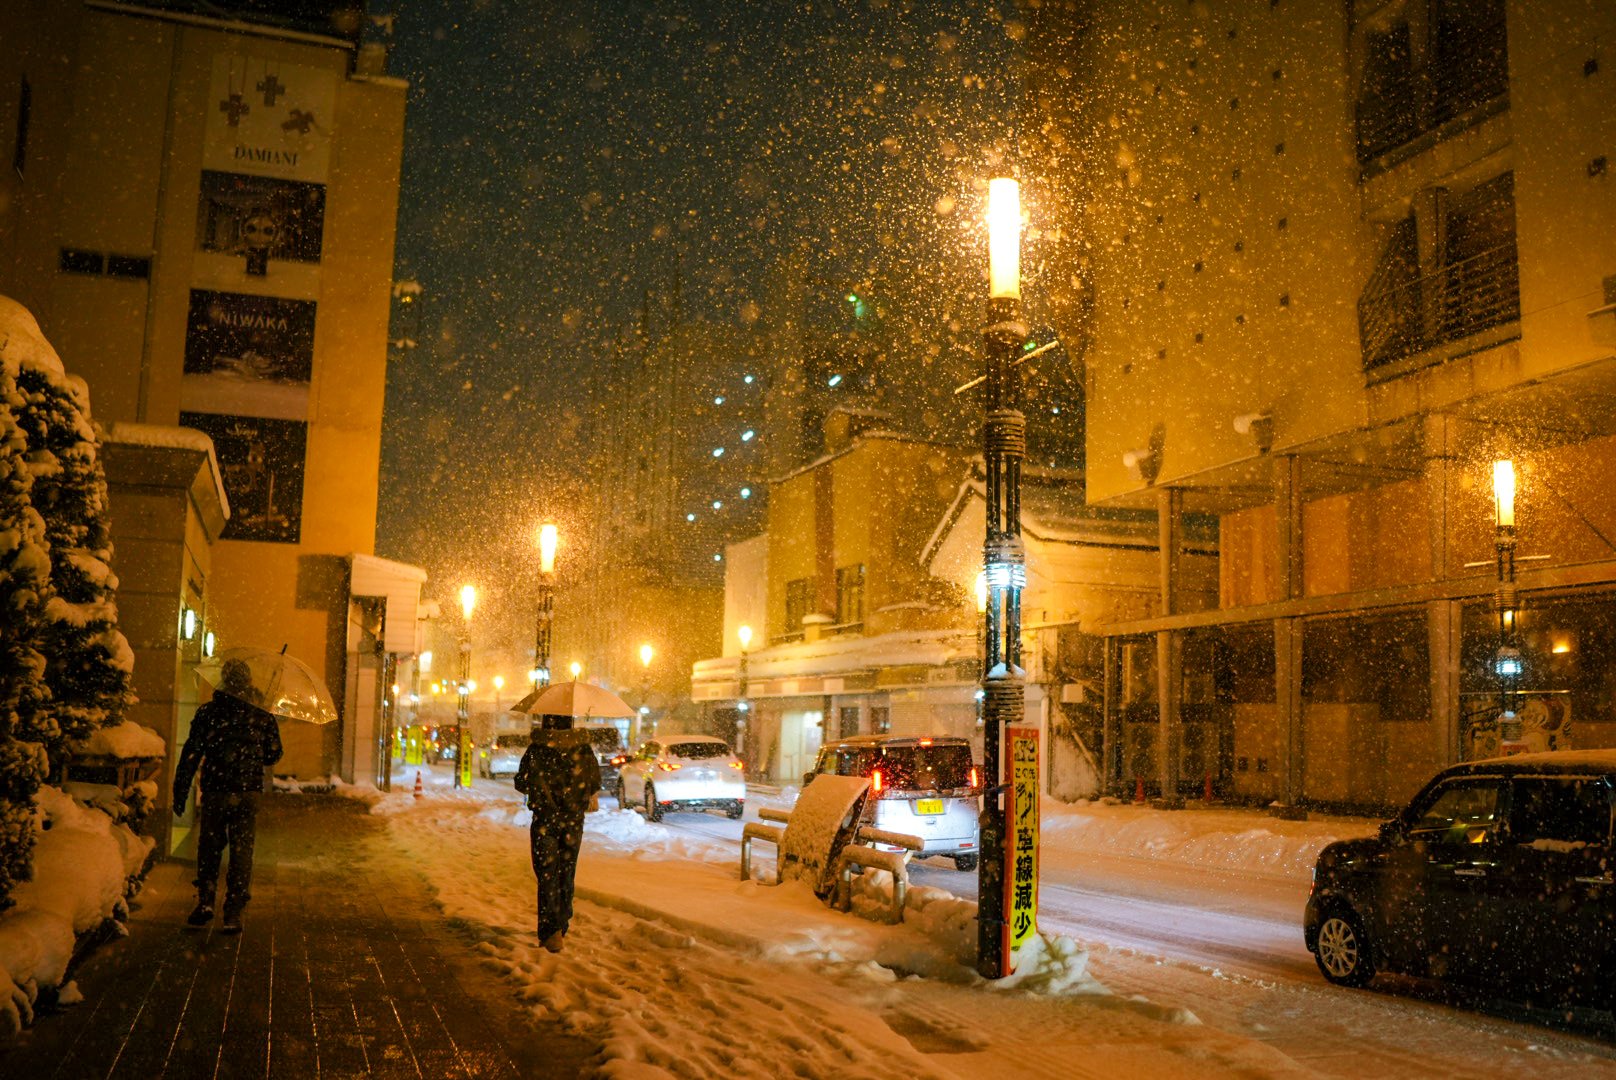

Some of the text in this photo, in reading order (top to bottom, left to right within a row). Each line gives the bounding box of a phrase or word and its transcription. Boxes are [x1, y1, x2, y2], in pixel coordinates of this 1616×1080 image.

[234, 146, 298, 166] DAMIANI
[219, 311, 288, 331] NIWAKA
[1014, 827, 1035, 940] 車線減少
